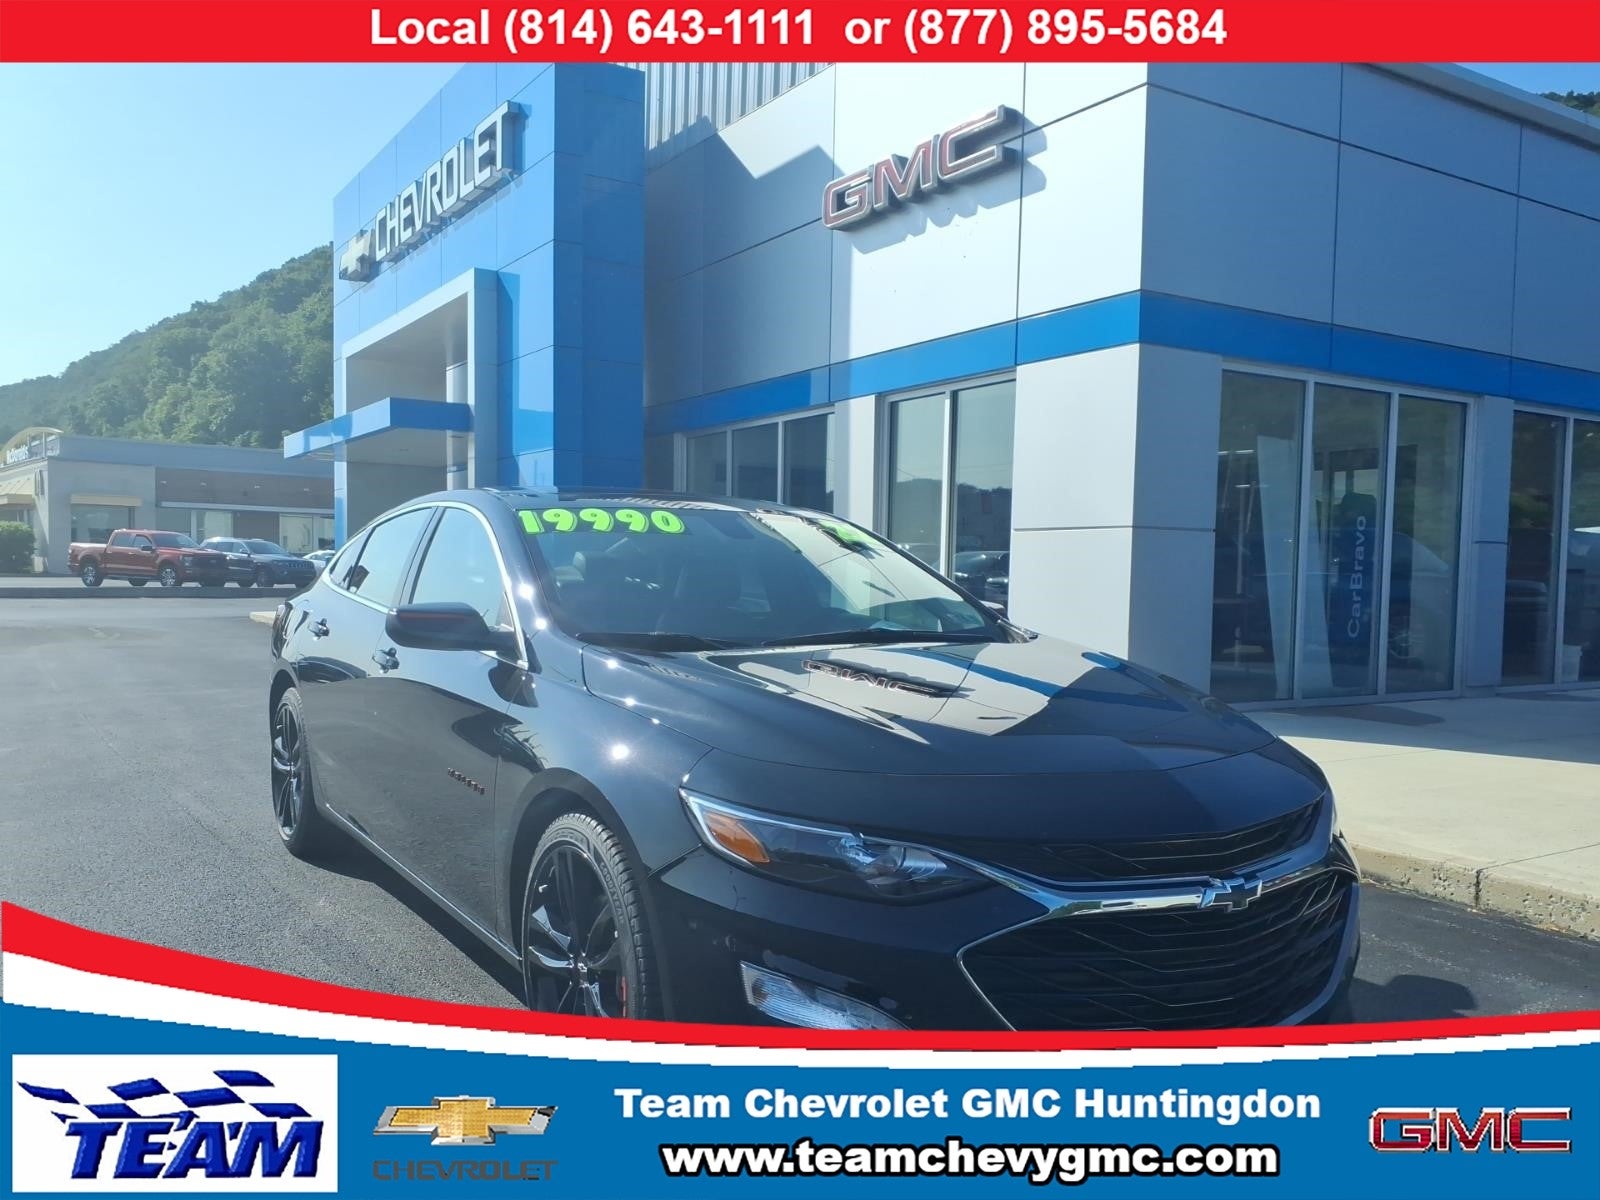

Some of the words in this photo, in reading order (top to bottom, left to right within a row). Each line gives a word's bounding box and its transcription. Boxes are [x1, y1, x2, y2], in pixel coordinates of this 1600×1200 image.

[374, 100, 510, 263] CHEVROLET
[822, 104, 1008, 230] GMC
[518, 507, 686, 534] 19990
[1347, 515, 1367, 637] CarBravo
